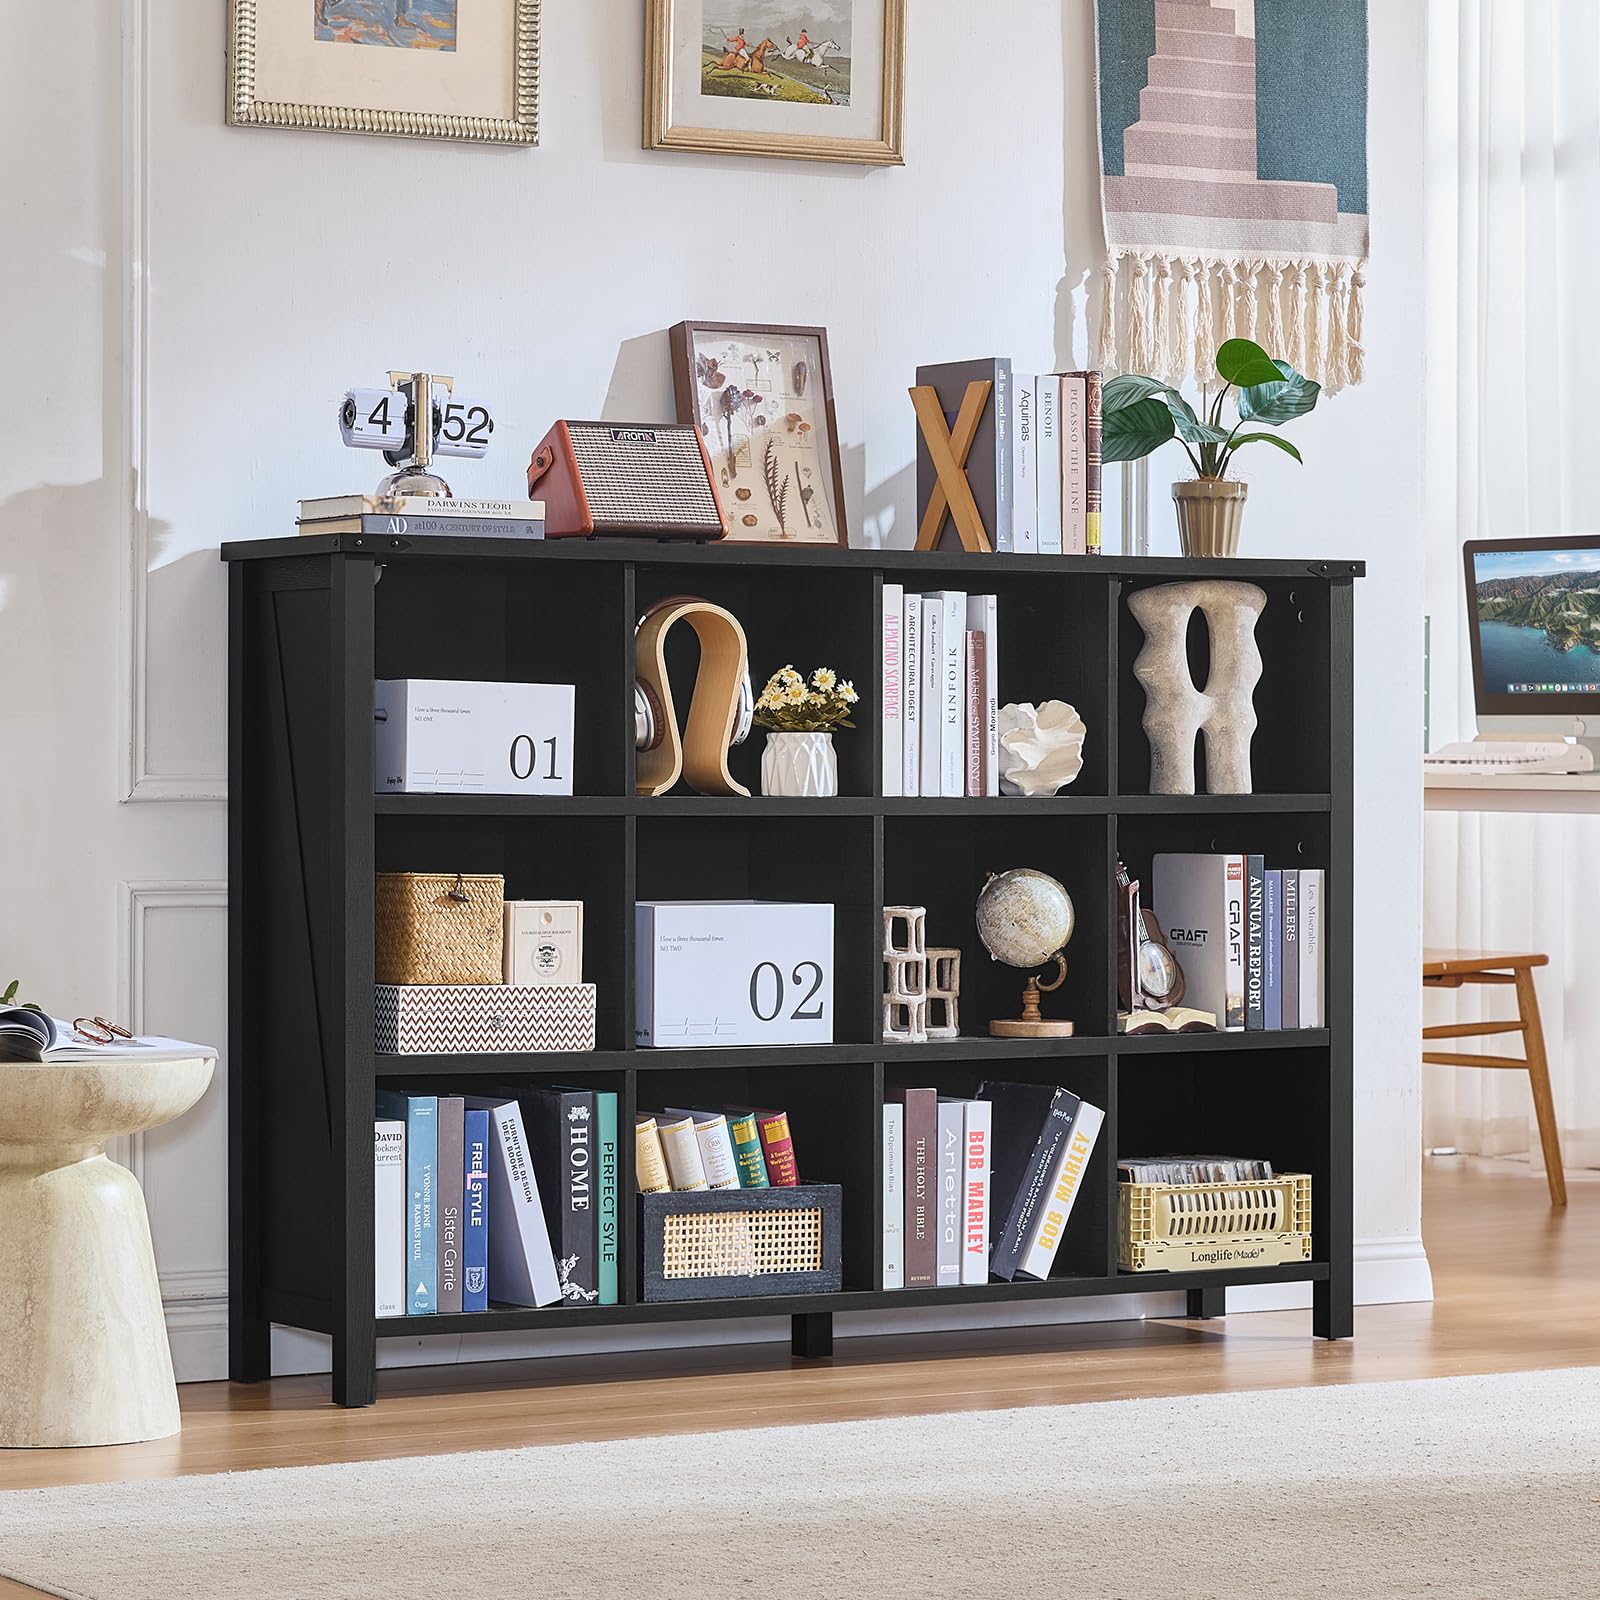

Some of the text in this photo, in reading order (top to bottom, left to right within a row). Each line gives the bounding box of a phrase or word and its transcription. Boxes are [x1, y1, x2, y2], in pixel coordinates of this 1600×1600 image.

[368, 397, 392, 435] 4
[998, 394, 1006, 417] good
[1000, 383, 1006, 392] in
[1019, 389, 1032, 442] Aquinas
[1044, 392, 1052, 438] RENOIR
[443, 404, 489, 444] 52
[1070, 389, 1079, 514] PICASSO THE LINE
[386, 517, 408, 534] AD
[427, 500, 512, 510] DARWINS TEORI
[445, 523, 481, 532] CENTURY
[493, 525, 514, 534] STYLE
[884, 614, 898, 720] AL PACINO SCARFACE
[908, 614, 916, 688] ARCHITECTURAL
[908, 690, 916, 722] DIGEST
[948, 648, 957, 724] KINFOLK
[972, 670, 980, 704] MUSIC
[510, 734, 562, 780] 01
[972, 717, 980, 782] SYMPHONY
[690, 934, 711, 942] thousand
[1170, 928, 1208, 942] CRAFT
[1229, 900, 1240, 966] CRAFT
[1286, 879, 1296, 942] MILLERS
[1308, 884, 1316, 955] Les Miserables
[1249, 876, 1262, 1011] ANNUAL REPORT
[750, 961, 824, 1022] 02
[500, 1121, 512, 1143] IDEA
[506, 1118, 534, 1203] FURNITURE DESIGN
[472, 1142, 482, 1226] FREE STYLE
[570, 1126, 590, 1212] HOME
[916, 1138, 925, 1240] THE HOLY BIBLE
[946, 1128, 958, 1243] Arletta
[968, 1131, 984, 1254] BOB MARLEY
[1038, 1130, 1090, 1250] BOB MARLEY
[604, 1142, 614, 1263] PERFECT SYLE
[444, 1208, 458, 1291] Sister Carrie
[1192, 1249, 1232, 1264] Longlife
